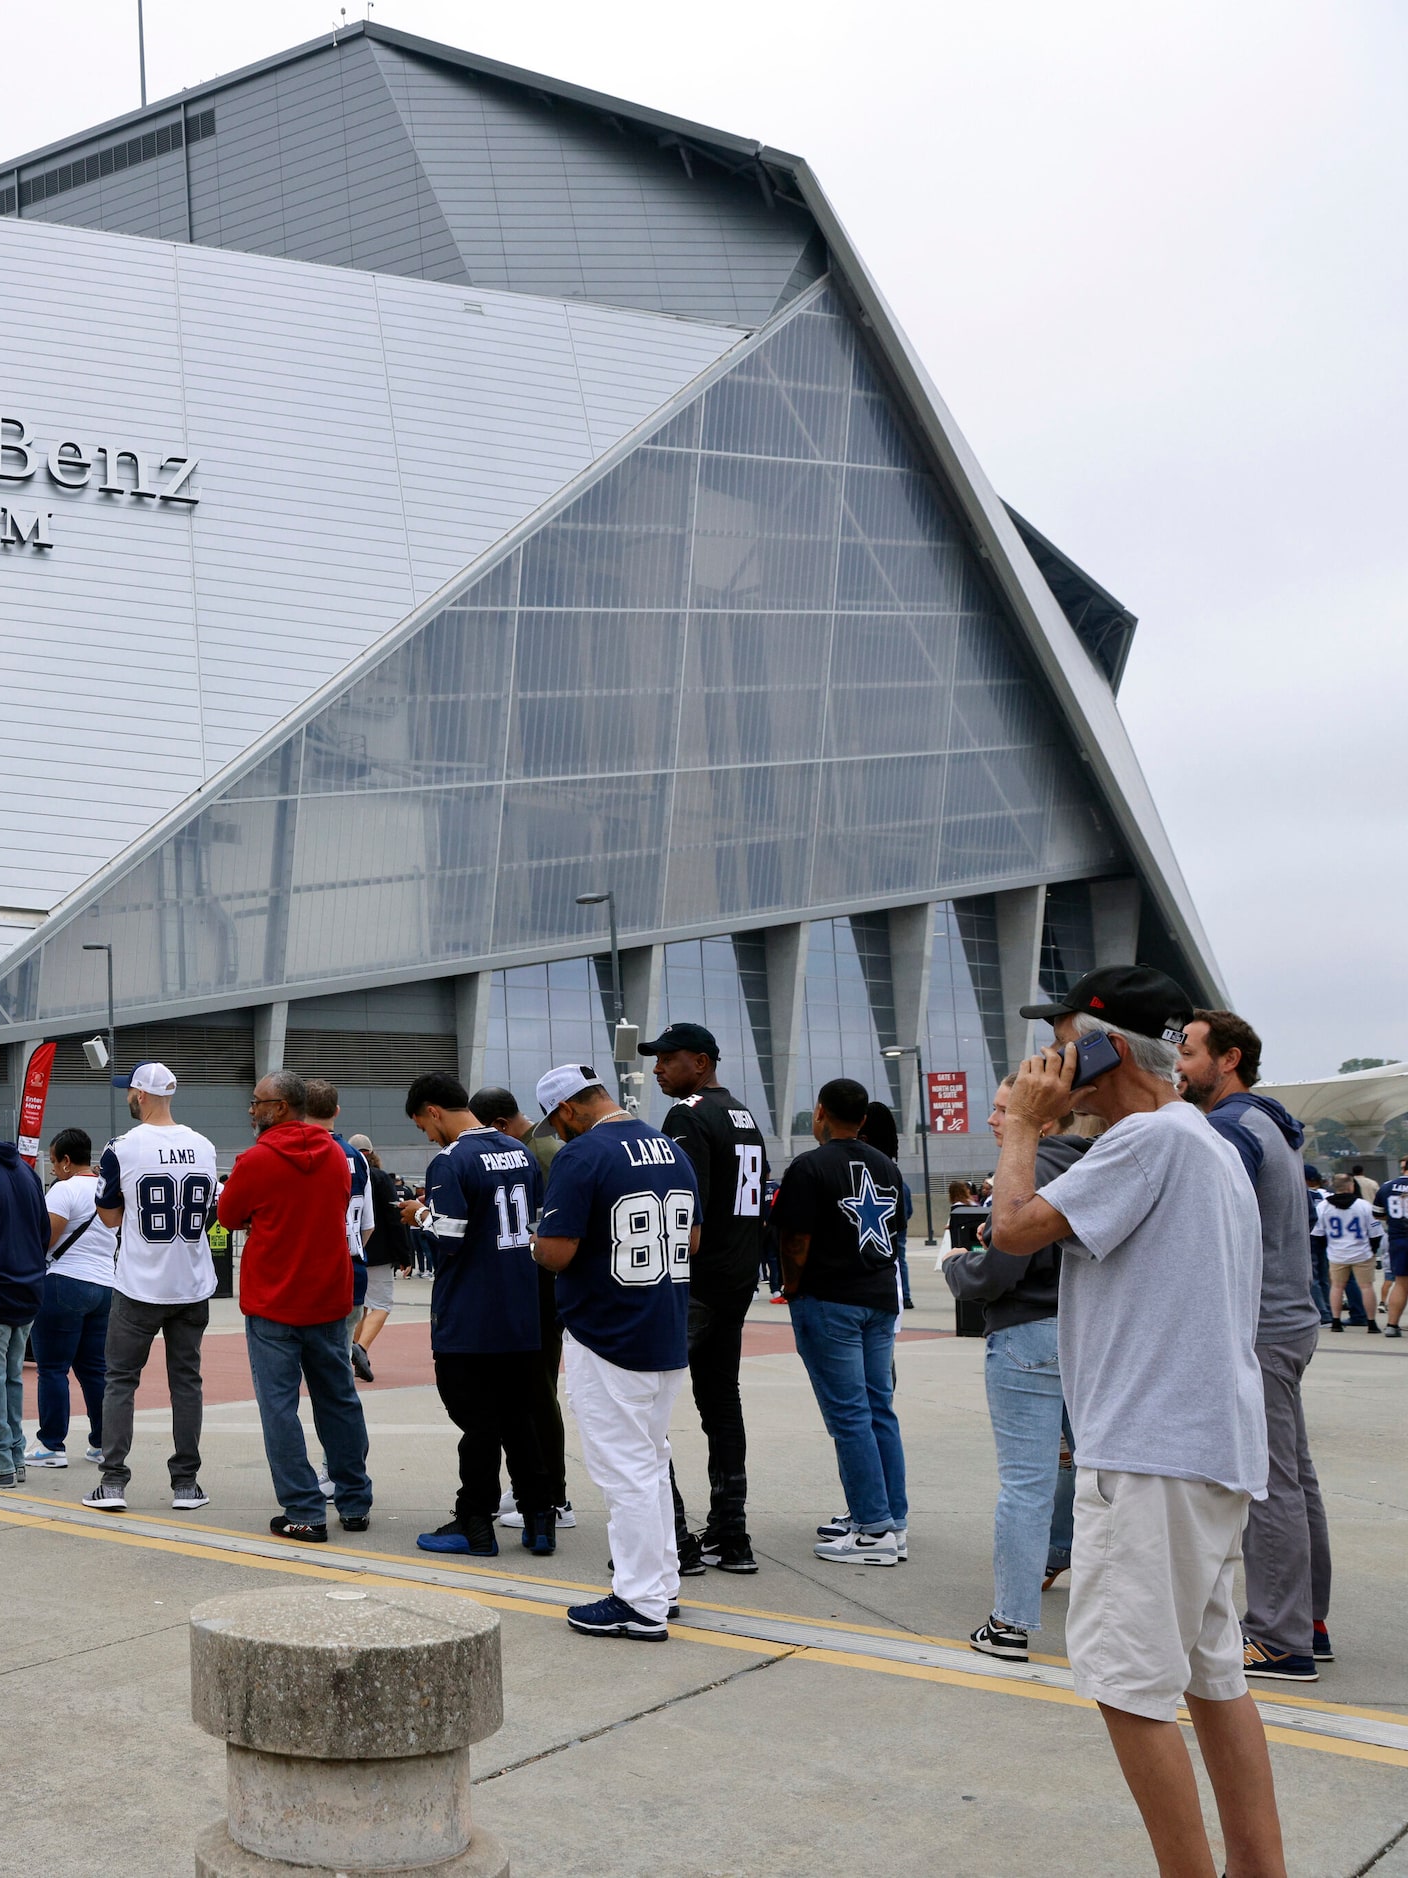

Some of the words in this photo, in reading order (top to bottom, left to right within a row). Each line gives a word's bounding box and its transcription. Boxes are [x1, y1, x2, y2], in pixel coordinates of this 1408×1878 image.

[25, 1096, 43, 1104] Enter
[158, 1149, 196, 1164] LAMB
[480, 1150, 529, 1171] PARSONS
[621, 1138, 675, 1167] LAMB
[733, 1144, 762, 1216] 18
[136, 1173, 214, 1243] 88
[494, 1184, 532, 1250] 11
[610, 1190, 694, 1286] 88
[1329, 1216, 1363, 1239] 94
